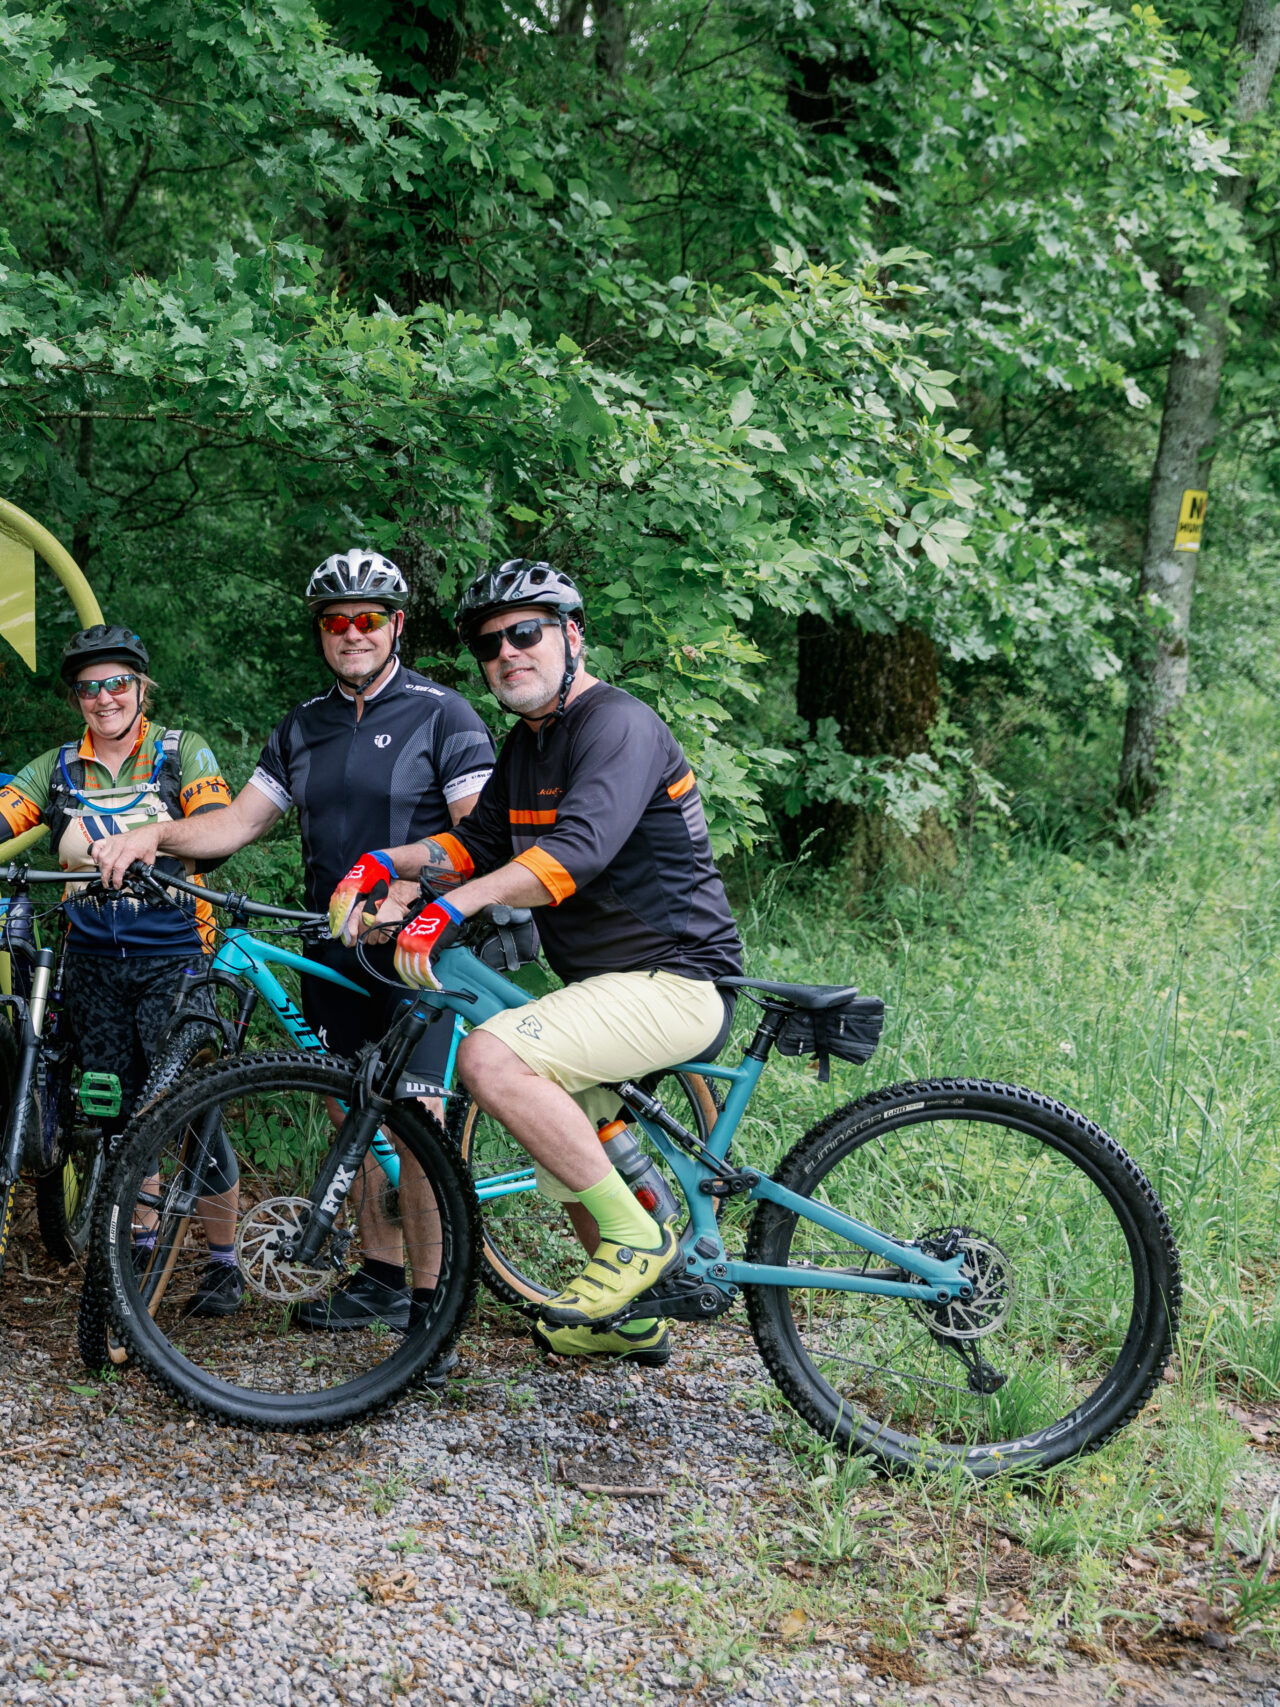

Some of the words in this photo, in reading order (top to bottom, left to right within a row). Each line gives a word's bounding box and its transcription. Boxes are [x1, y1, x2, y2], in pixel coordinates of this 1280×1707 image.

[804, 1113, 882, 1176] ELIMINATOR
[319, 1163, 358, 1216] FOX
[109, 1245, 131, 1316] BUTCHER
